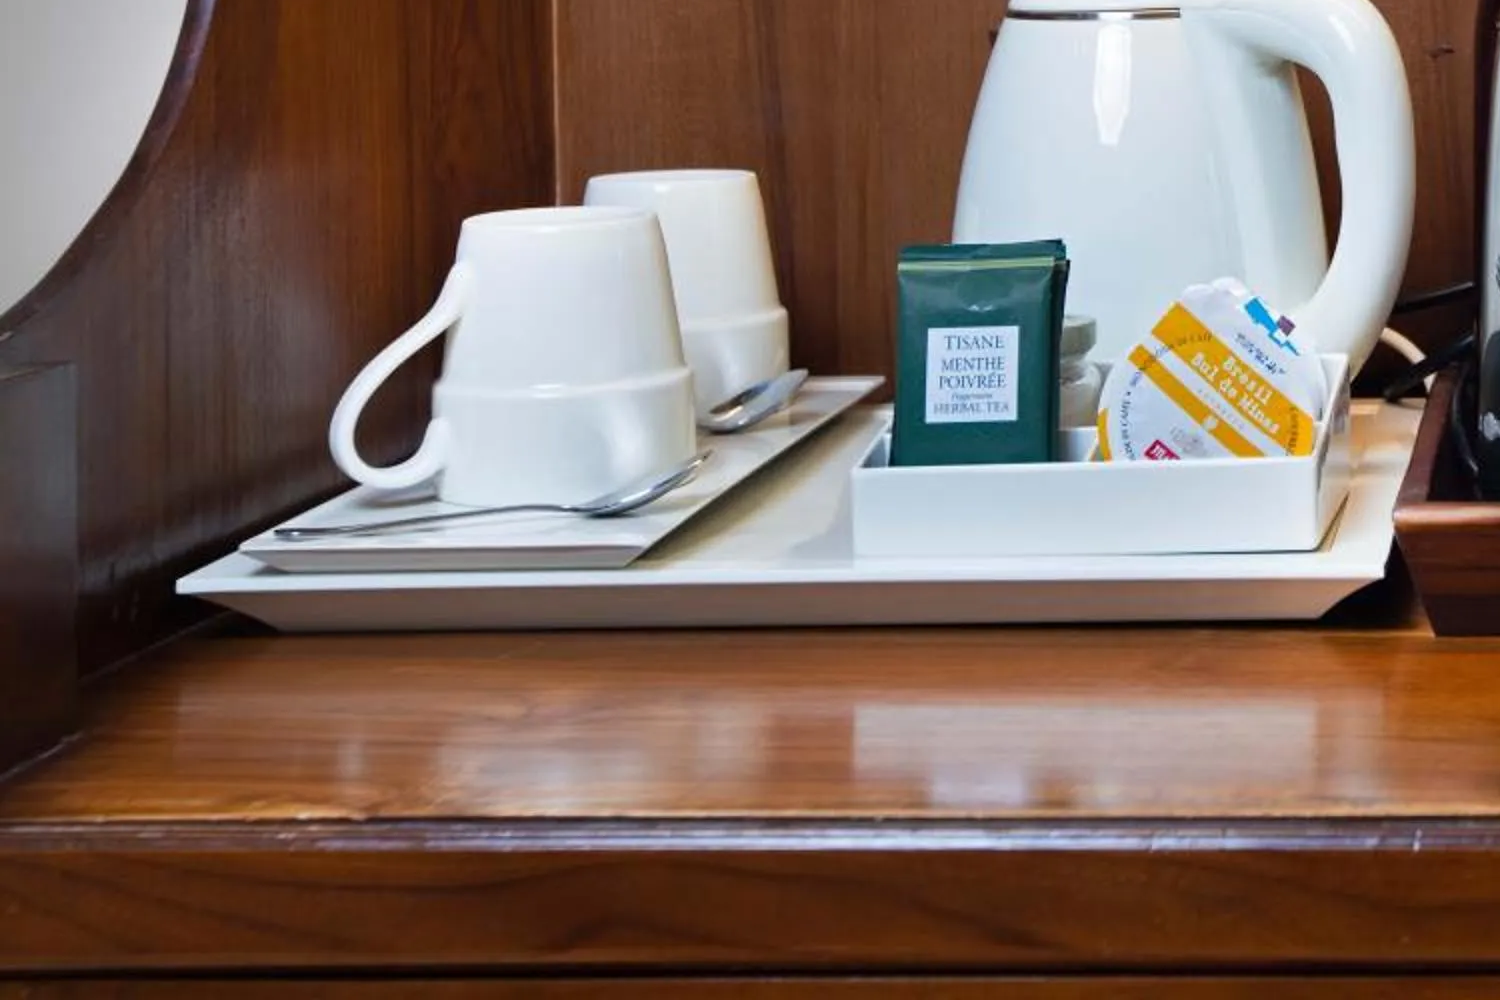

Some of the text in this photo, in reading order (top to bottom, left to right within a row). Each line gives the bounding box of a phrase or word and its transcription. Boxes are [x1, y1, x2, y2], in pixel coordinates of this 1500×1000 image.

[943, 335, 1004, 350] TISANE
[941, 356, 1005, 372] MENTHE
[938, 372, 1007, 389] POIVRÉE
[934, 401, 1009, 415] HERBAL TEA
